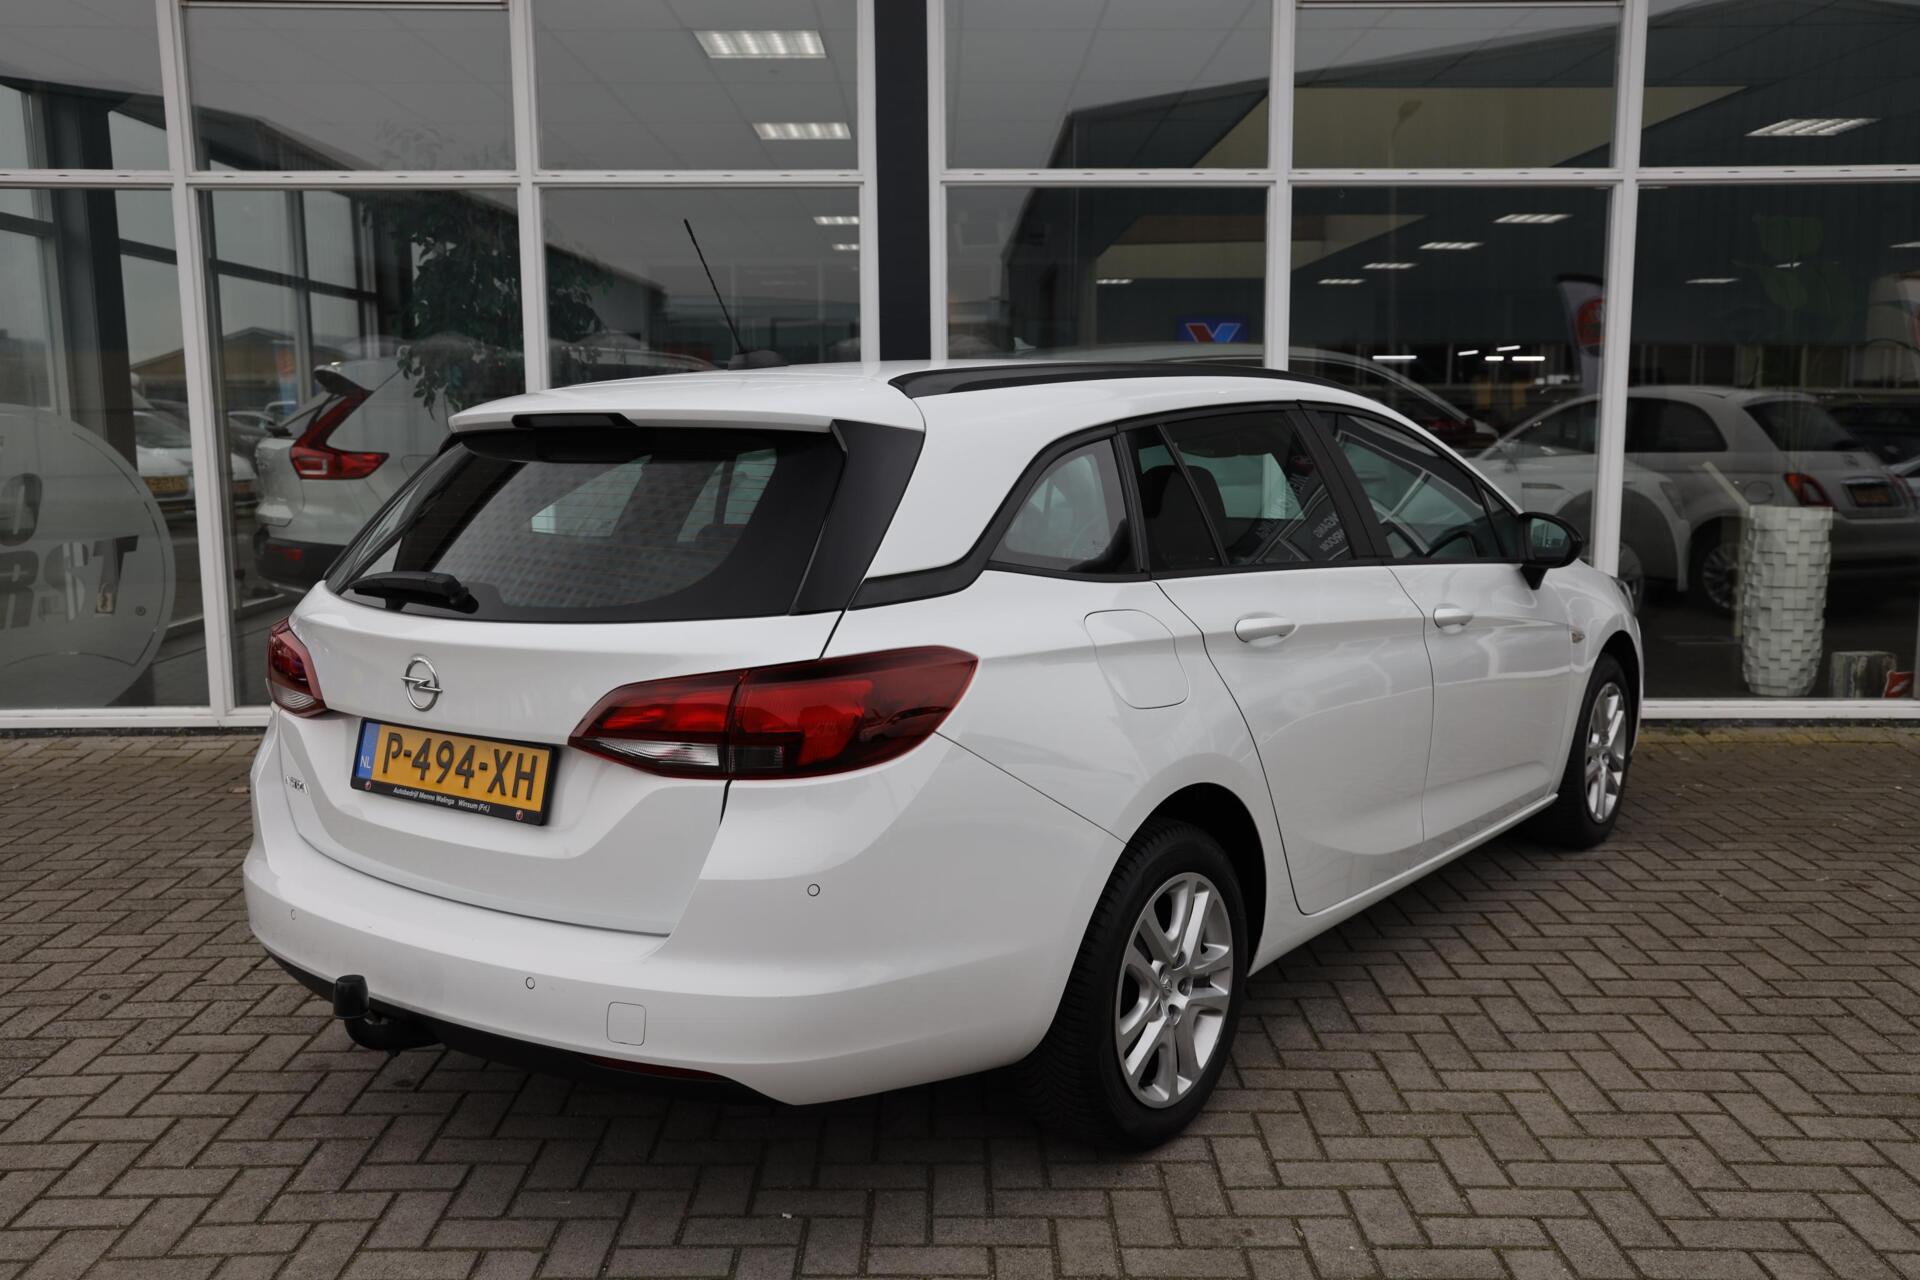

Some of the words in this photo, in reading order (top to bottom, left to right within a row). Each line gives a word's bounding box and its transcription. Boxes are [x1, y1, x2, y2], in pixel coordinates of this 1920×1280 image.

[359, 754, 372, 770] NL
[382, 732, 538, 801] P-494-XH
[458, 799, 478, 810] Winsum
